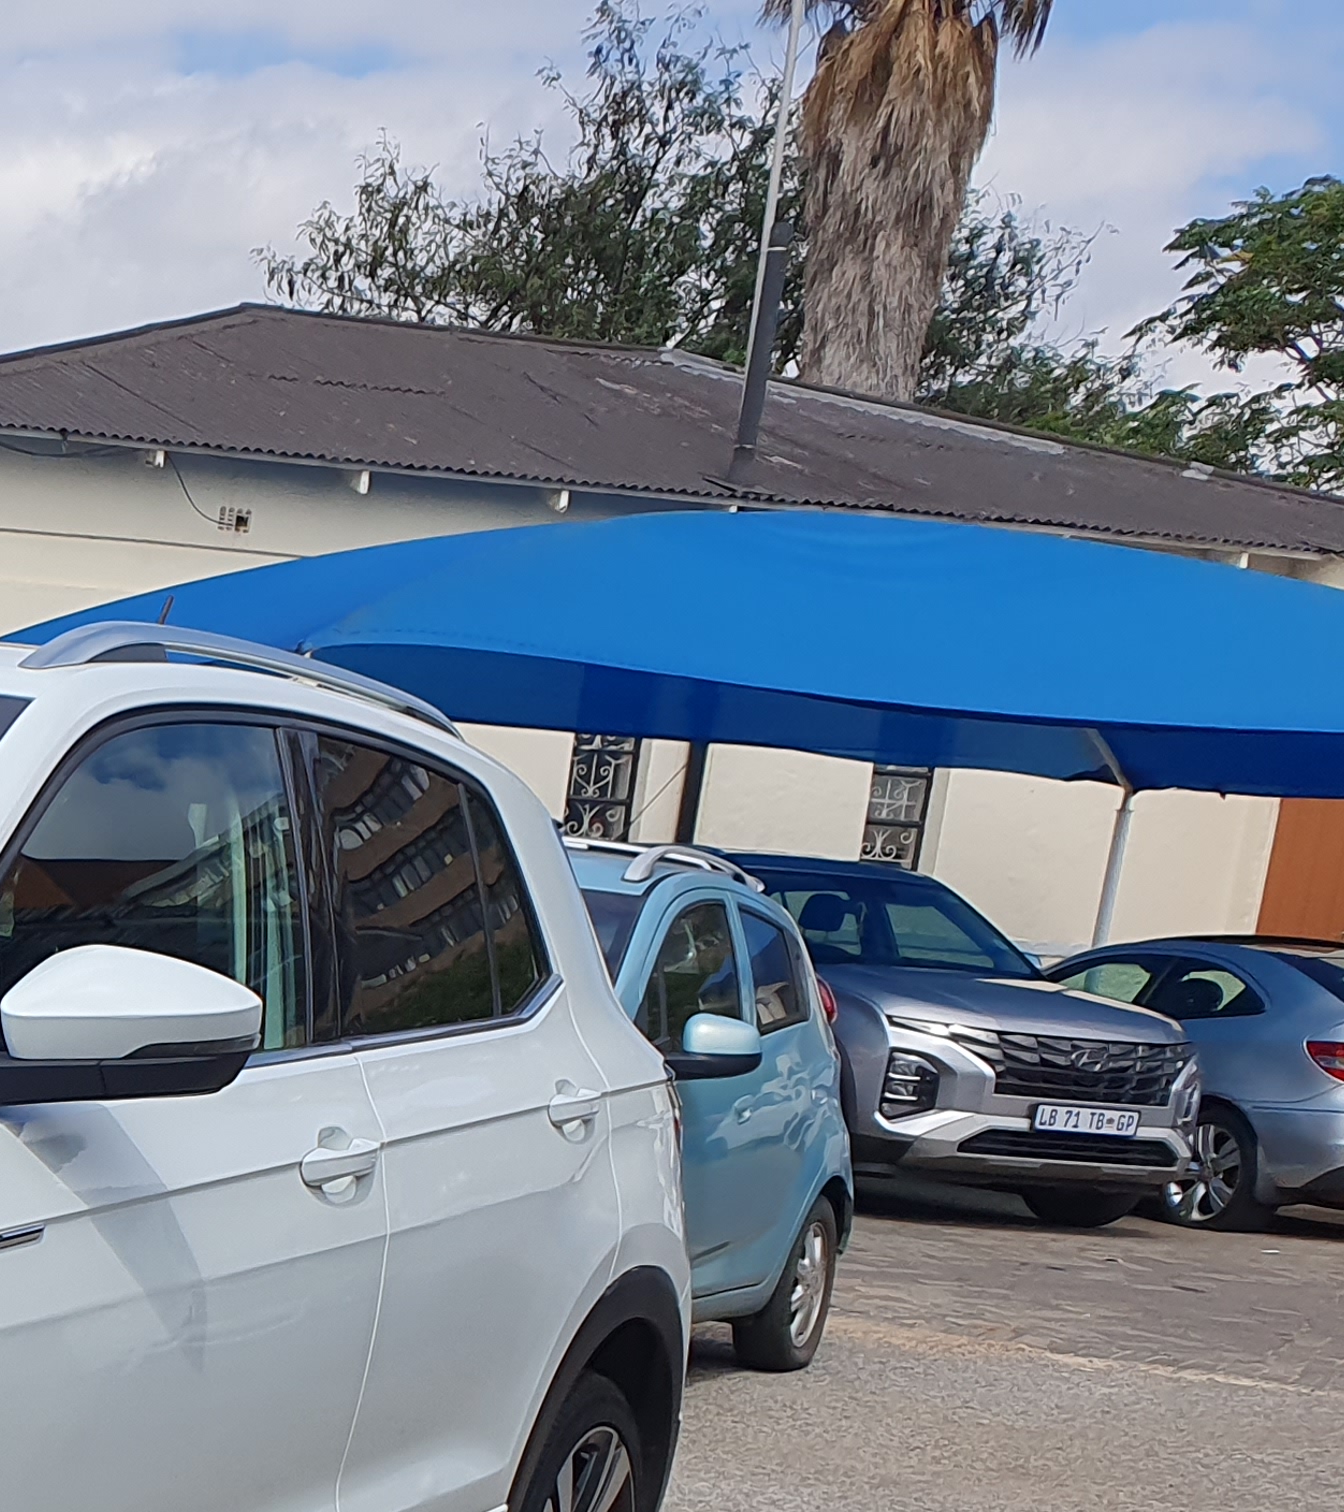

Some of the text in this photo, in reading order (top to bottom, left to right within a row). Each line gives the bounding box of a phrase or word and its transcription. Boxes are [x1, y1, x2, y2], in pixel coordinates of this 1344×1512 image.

[1039, 1108, 1135, 1132] LB 71 TB GP
